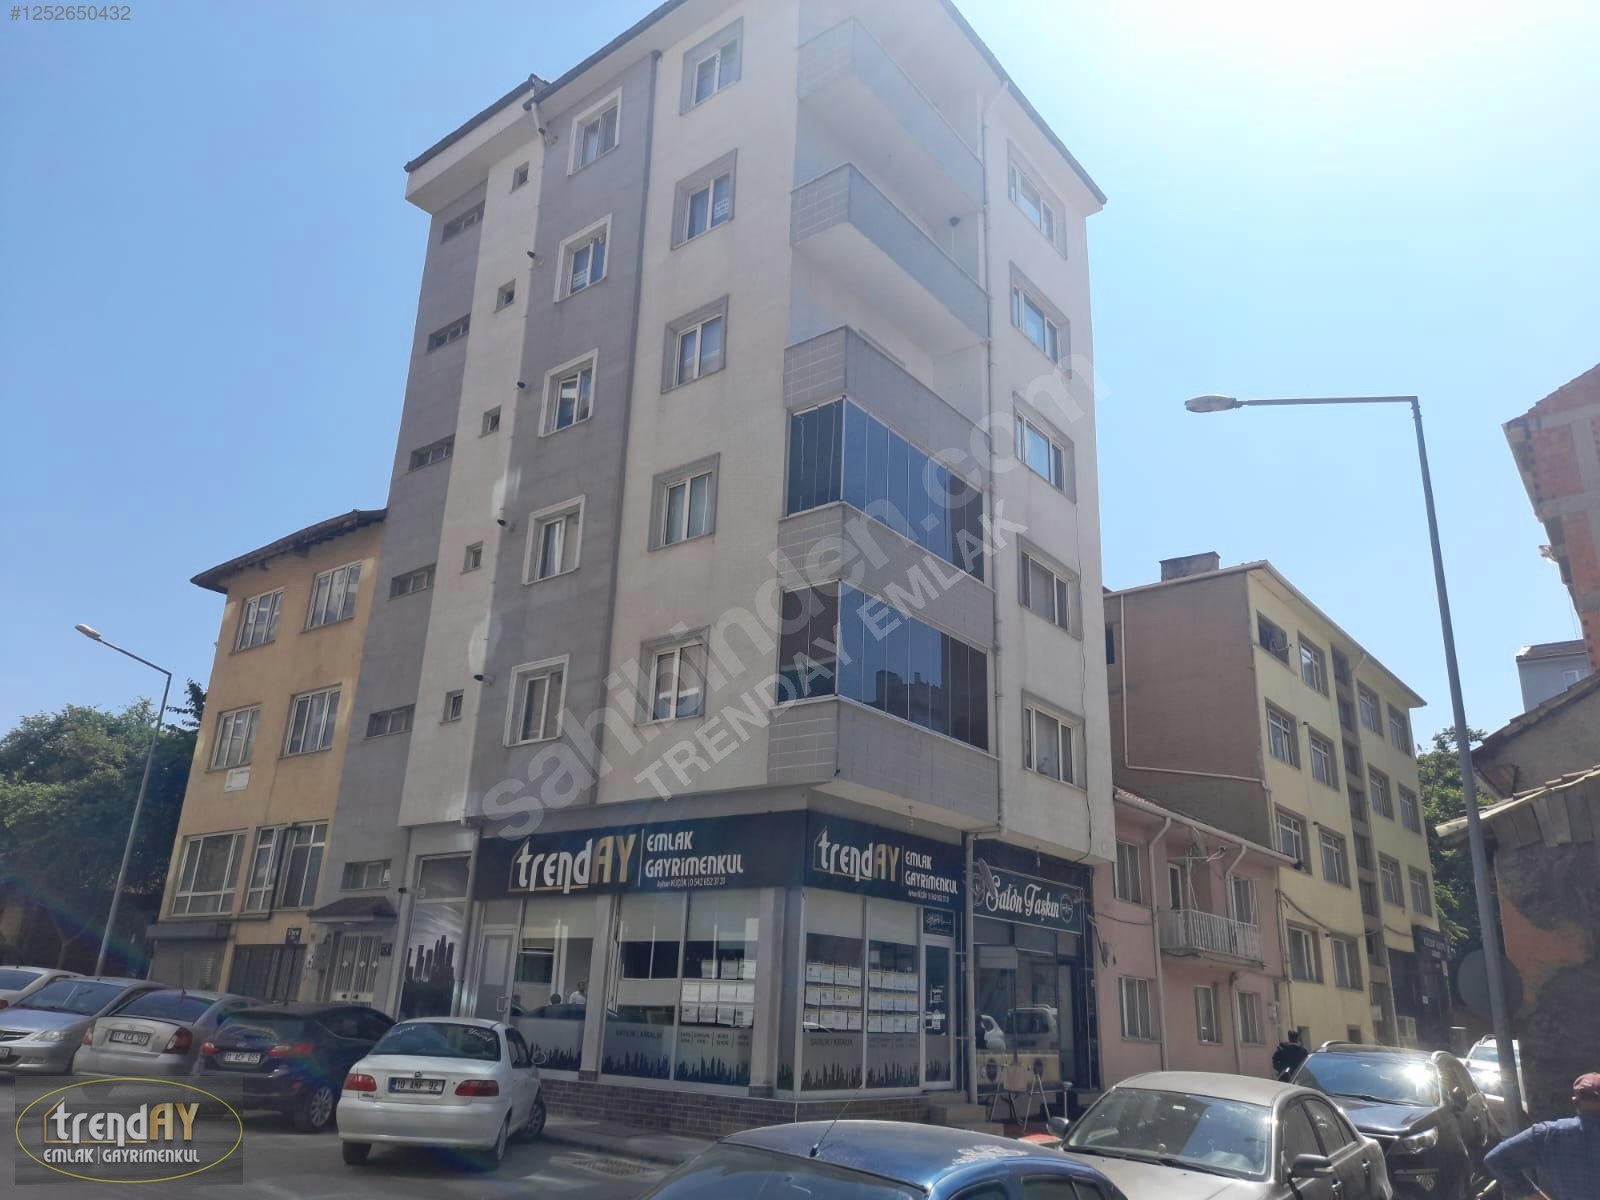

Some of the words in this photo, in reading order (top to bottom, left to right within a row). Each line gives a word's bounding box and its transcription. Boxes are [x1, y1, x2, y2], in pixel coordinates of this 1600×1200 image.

[646, 831, 693, 851] EMLAK
[817, 830, 900, 882] trendAY
[516, 834, 636, 894] trendAY
[905, 850, 932, 870] EMLAK
